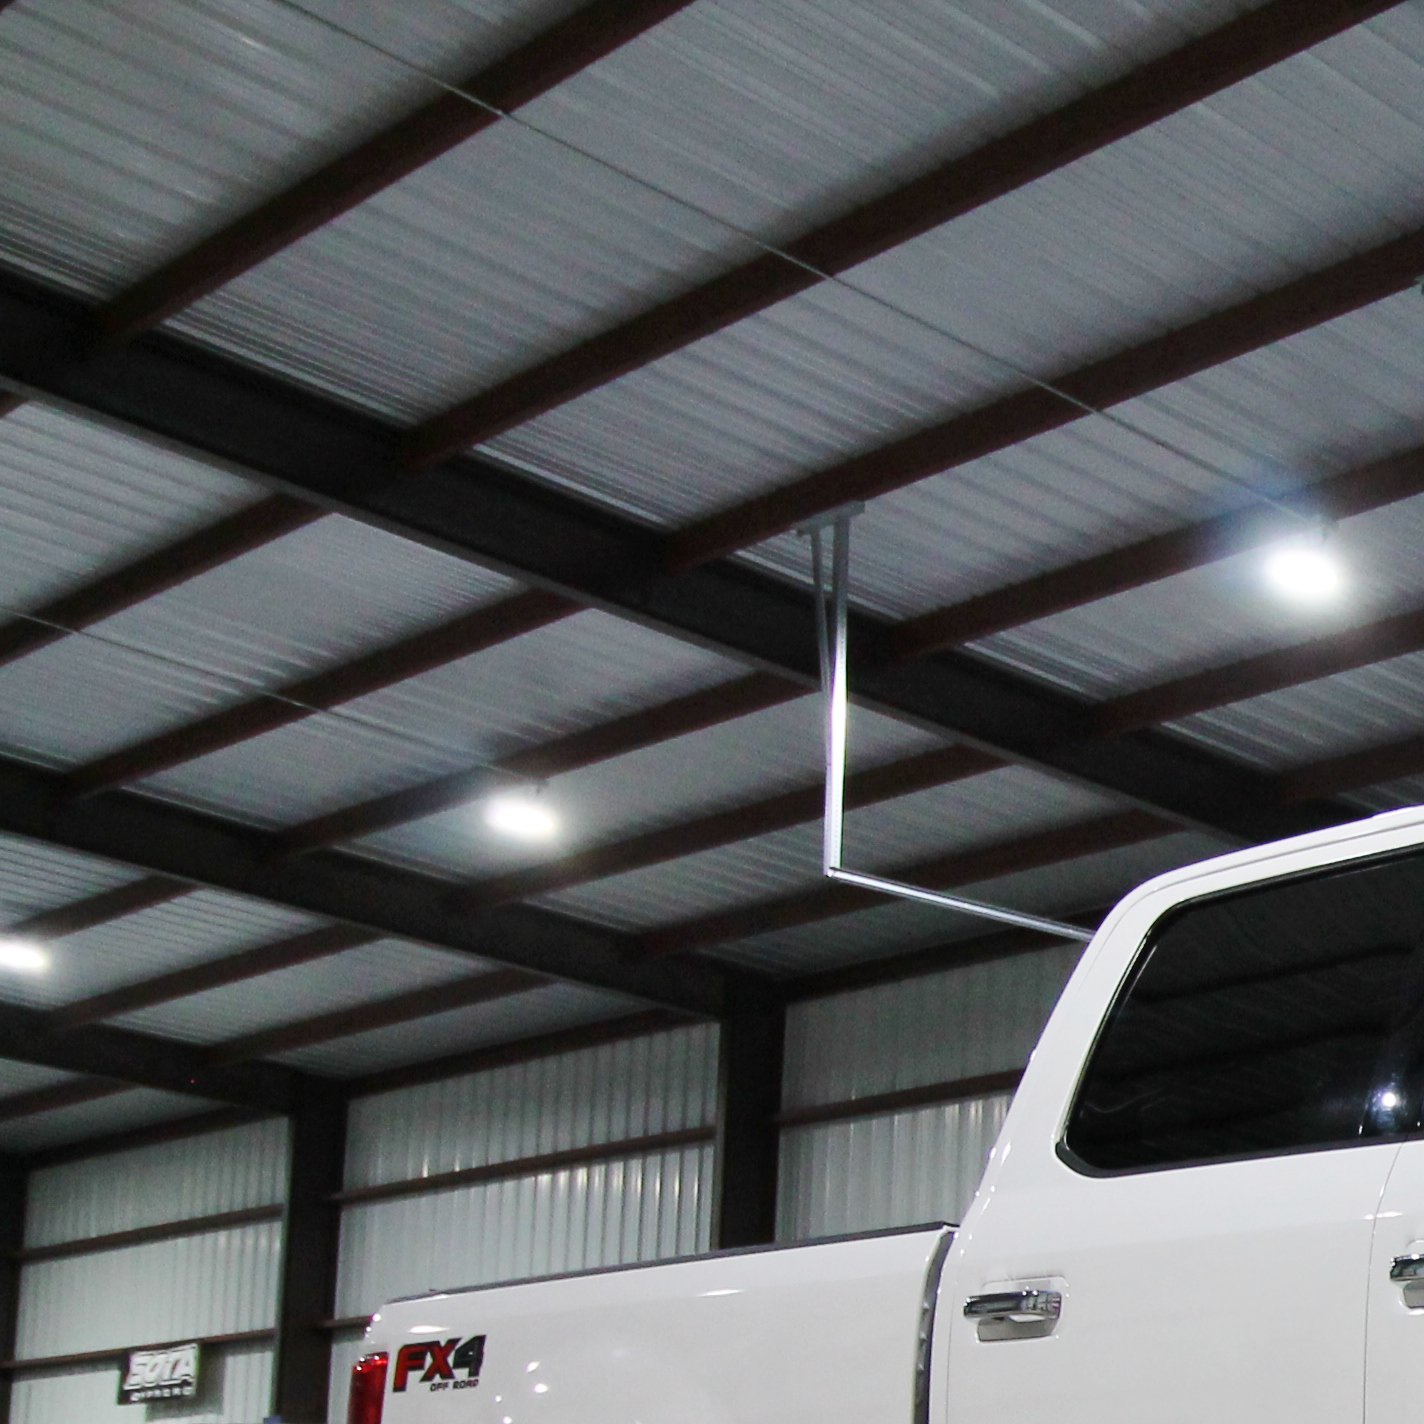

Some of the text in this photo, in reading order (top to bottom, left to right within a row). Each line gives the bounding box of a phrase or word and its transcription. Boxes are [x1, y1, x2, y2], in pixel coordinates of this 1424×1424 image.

[393, 1335, 486, 1392] FX4
[430, 1379, 479, 1392] OFF ROAD
